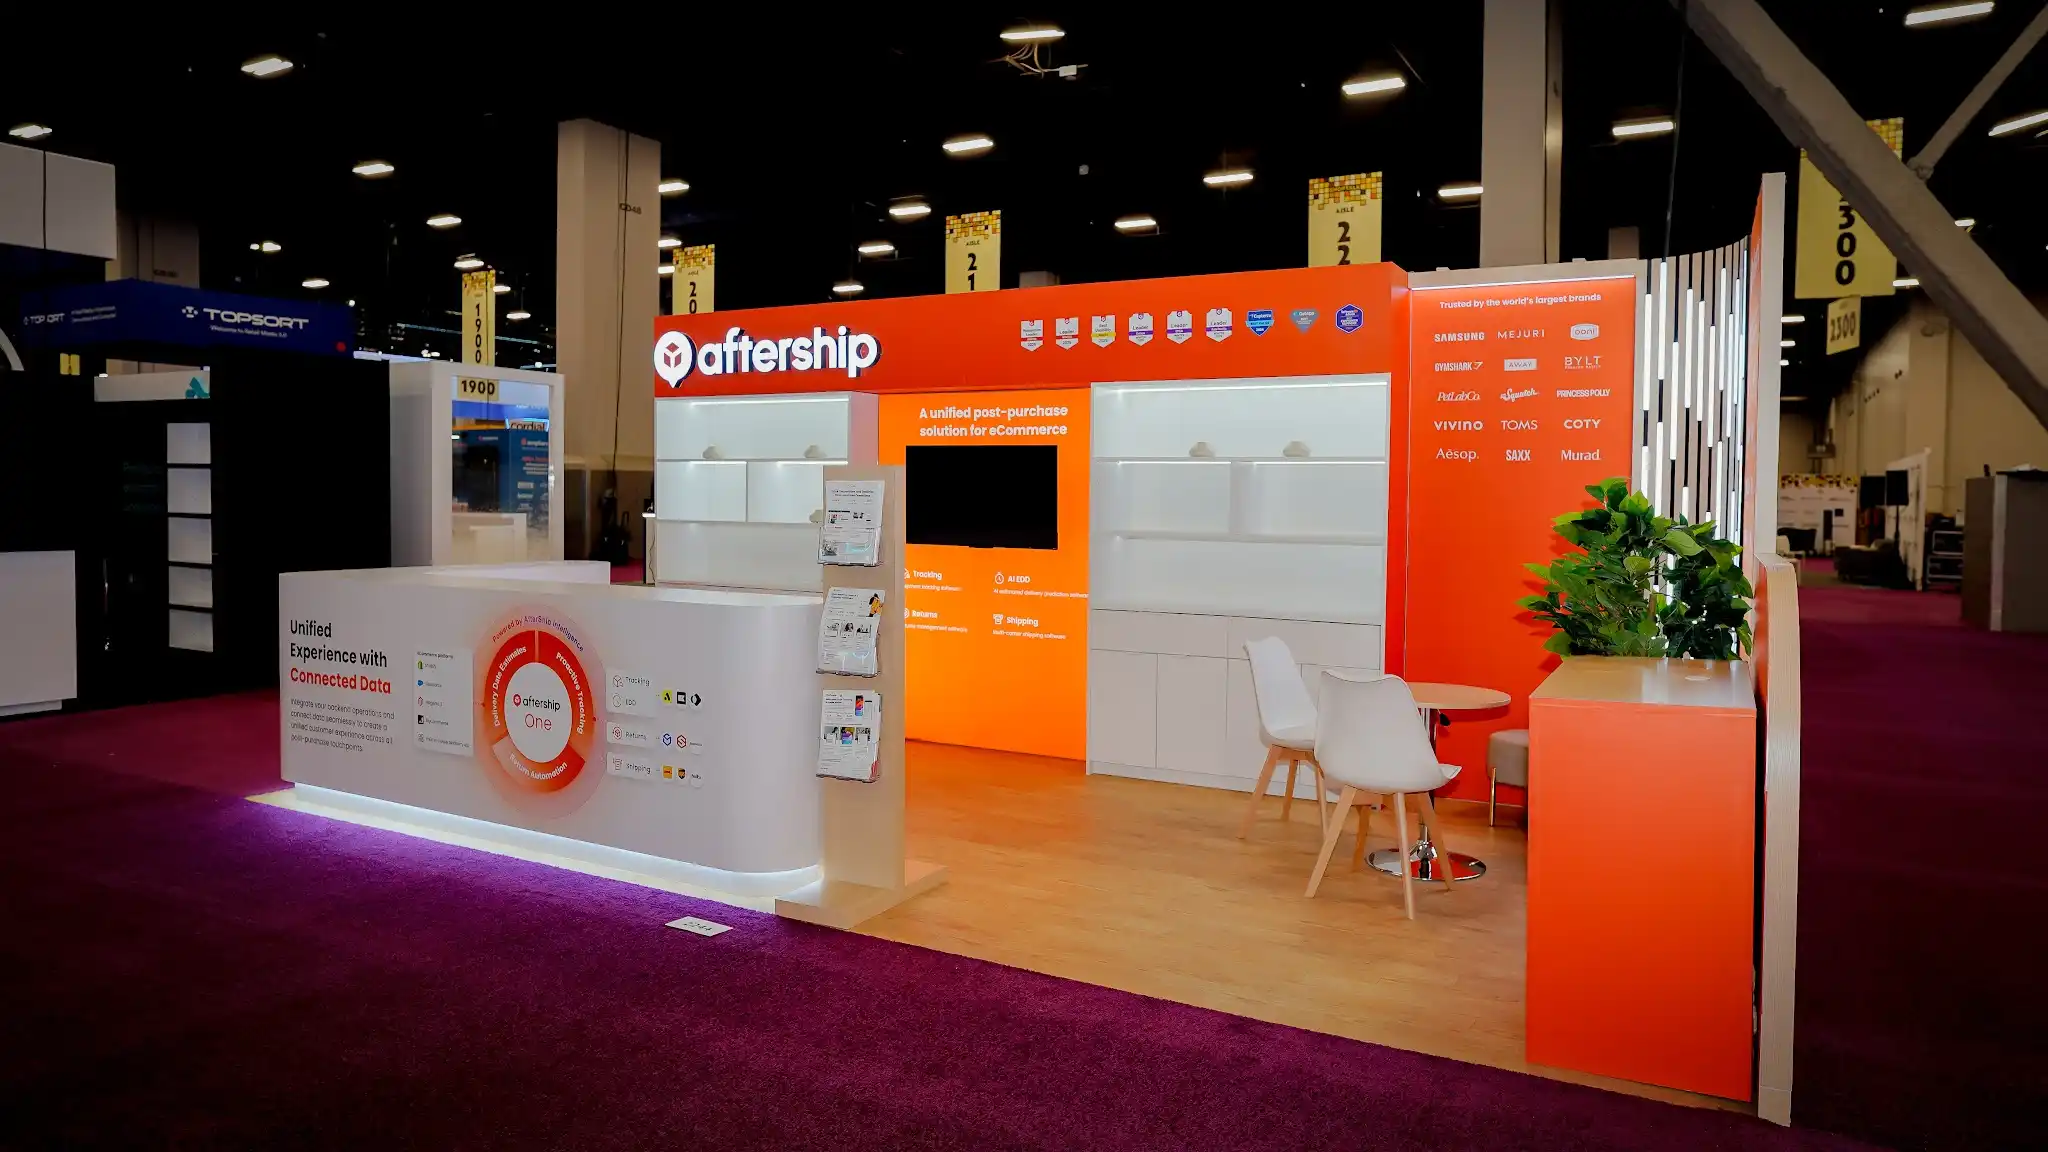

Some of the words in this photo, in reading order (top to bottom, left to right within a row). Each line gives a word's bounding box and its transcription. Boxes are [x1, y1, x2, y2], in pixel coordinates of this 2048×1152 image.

[1335, 206, 1355, 214] AISLE
[1835, 198, 1858, 287] 300
[1439, 301, 1472, 309] Trusted
[1473, 300, 1484, 309] by
[1486, 299, 1500, 307] the
[1502, 297, 1534, 306] world's
[1535, 295, 1567, 305] largest
[1568, 293, 1601, 302] brands
[30, 313, 65, 324] TOPORT
[202, 307, 310, 330] TOPSORT
[474, 303, 482, 363] 1900
[1434, 332, 1485, 342] SAMSUNG
[1497, 329, 1545, 340] MEJURI
[697, 325, 880, 378] aftership
[1434, 361, 1473, 372] GYMSHARK
[1508, 361, 1533, 369] AWAY
[1564, 355, 1601, 366] BYLT
[461, 380, 495, 395] 1900
[1556, 389, 1589, 398] PRINCESS
[1589, 388, 1611, 397] POLLY
[919, 407, 928, 419] A
[930, 406, 971, 419] unified
[973, 404, 1069, 421] post-purchase
[919, 424, 968, 437] solution
[969, 424, 987, 436] for
[989, 423, 1068, 437] eCommerce
[1501, 420, 1538, 430] TOMS
[1563, 418, 1601, 429] COTY
[1505, 449, 1531, 461] SAXX
[913, 570, 943, 581] Tracking
[1007, 575, 1016, 584] AI
[1016, 575, 1031, 584] EDD
[911, 609, 938, 619] Returns
[290, 619, 332, 638] Unified
[1006, 616, 1039, 627] Shipping
[492, 620, 514, 643] Powered
[515, 618, 523, 627] by
[290, 642, 357, 664] Experience
[359, 649, 388, 668] with
[499, 646, 527, 671] Estimates
[290, 667, 357, 690] Connected
[360, 675, 391, 694] Data
[492, 671, 503, 690] Date
[624, 676, 651, 687] Tracking
[556, 652, 580, 691] Proactive
[577, 691, 587, 735] Tracking
[491, 690, 501, 727] Delivery
[522, 695, 561, 713] aftership
[383, 711, 395, 720] and
[525, 713, 552, 731] One
[625, 731, 648, 741] Returns
[509, 752, 530, 777] Return
[530, 761, 568, 781] Automation
